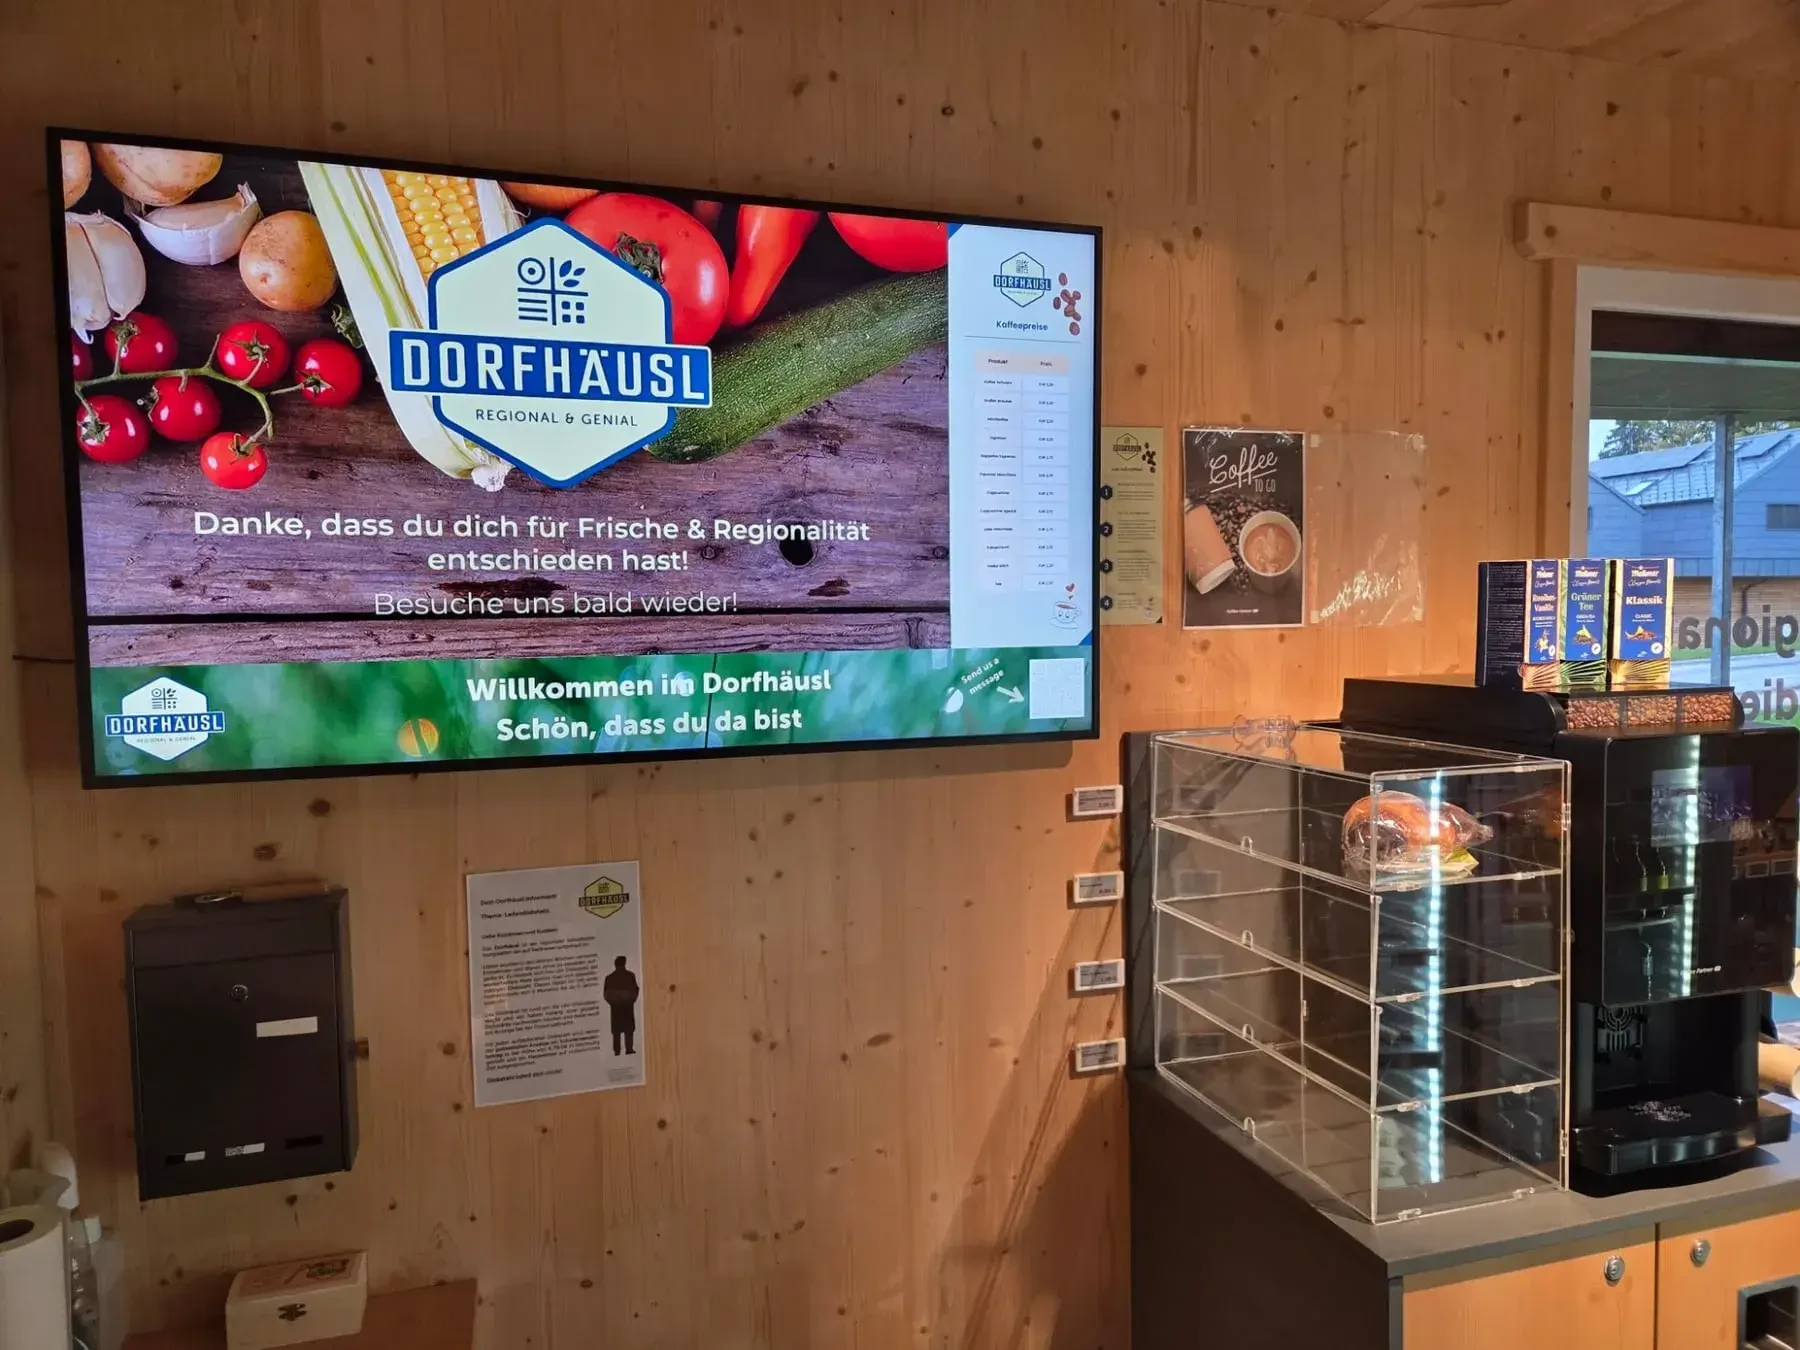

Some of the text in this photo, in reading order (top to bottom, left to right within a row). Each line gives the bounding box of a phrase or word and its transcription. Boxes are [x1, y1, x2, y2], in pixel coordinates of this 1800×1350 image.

[996, 275, 1051, 291] DORFHÄUSL
[996, 320, 1049, 332] Kaffeepreise
[401, 338, 705, 400] DORFHÄUSL
[475, 408, 638, 427] REGIONAL & GENIAL
[1208, 443, 1278, 489] Coffee
[1255, 478, 1277, 493] TO GO
[194, 511, 871, 545] Danke, dass du dich für Frische & Regionalität
[427, 548, 689, 572] entschieden hast!
[374, 591, 738, 616] Besuche uns bald wieder!
[1571, 592, 1602, 601] Grüner
[1579, 602, 1594, 611] Tee
[1625, 595, 1663, 605] Klassik
[961, 665, 983, 684] Send
[982, 660, 994, 672] us
[968, 669, 1005, 695] message
[466, 669, 832, 702] Willkommen im Dorfhäusl
[110, 714, 223, 734] DORFHÄUSL
[496, 708, 803, 742] Schön, dass du da bist
